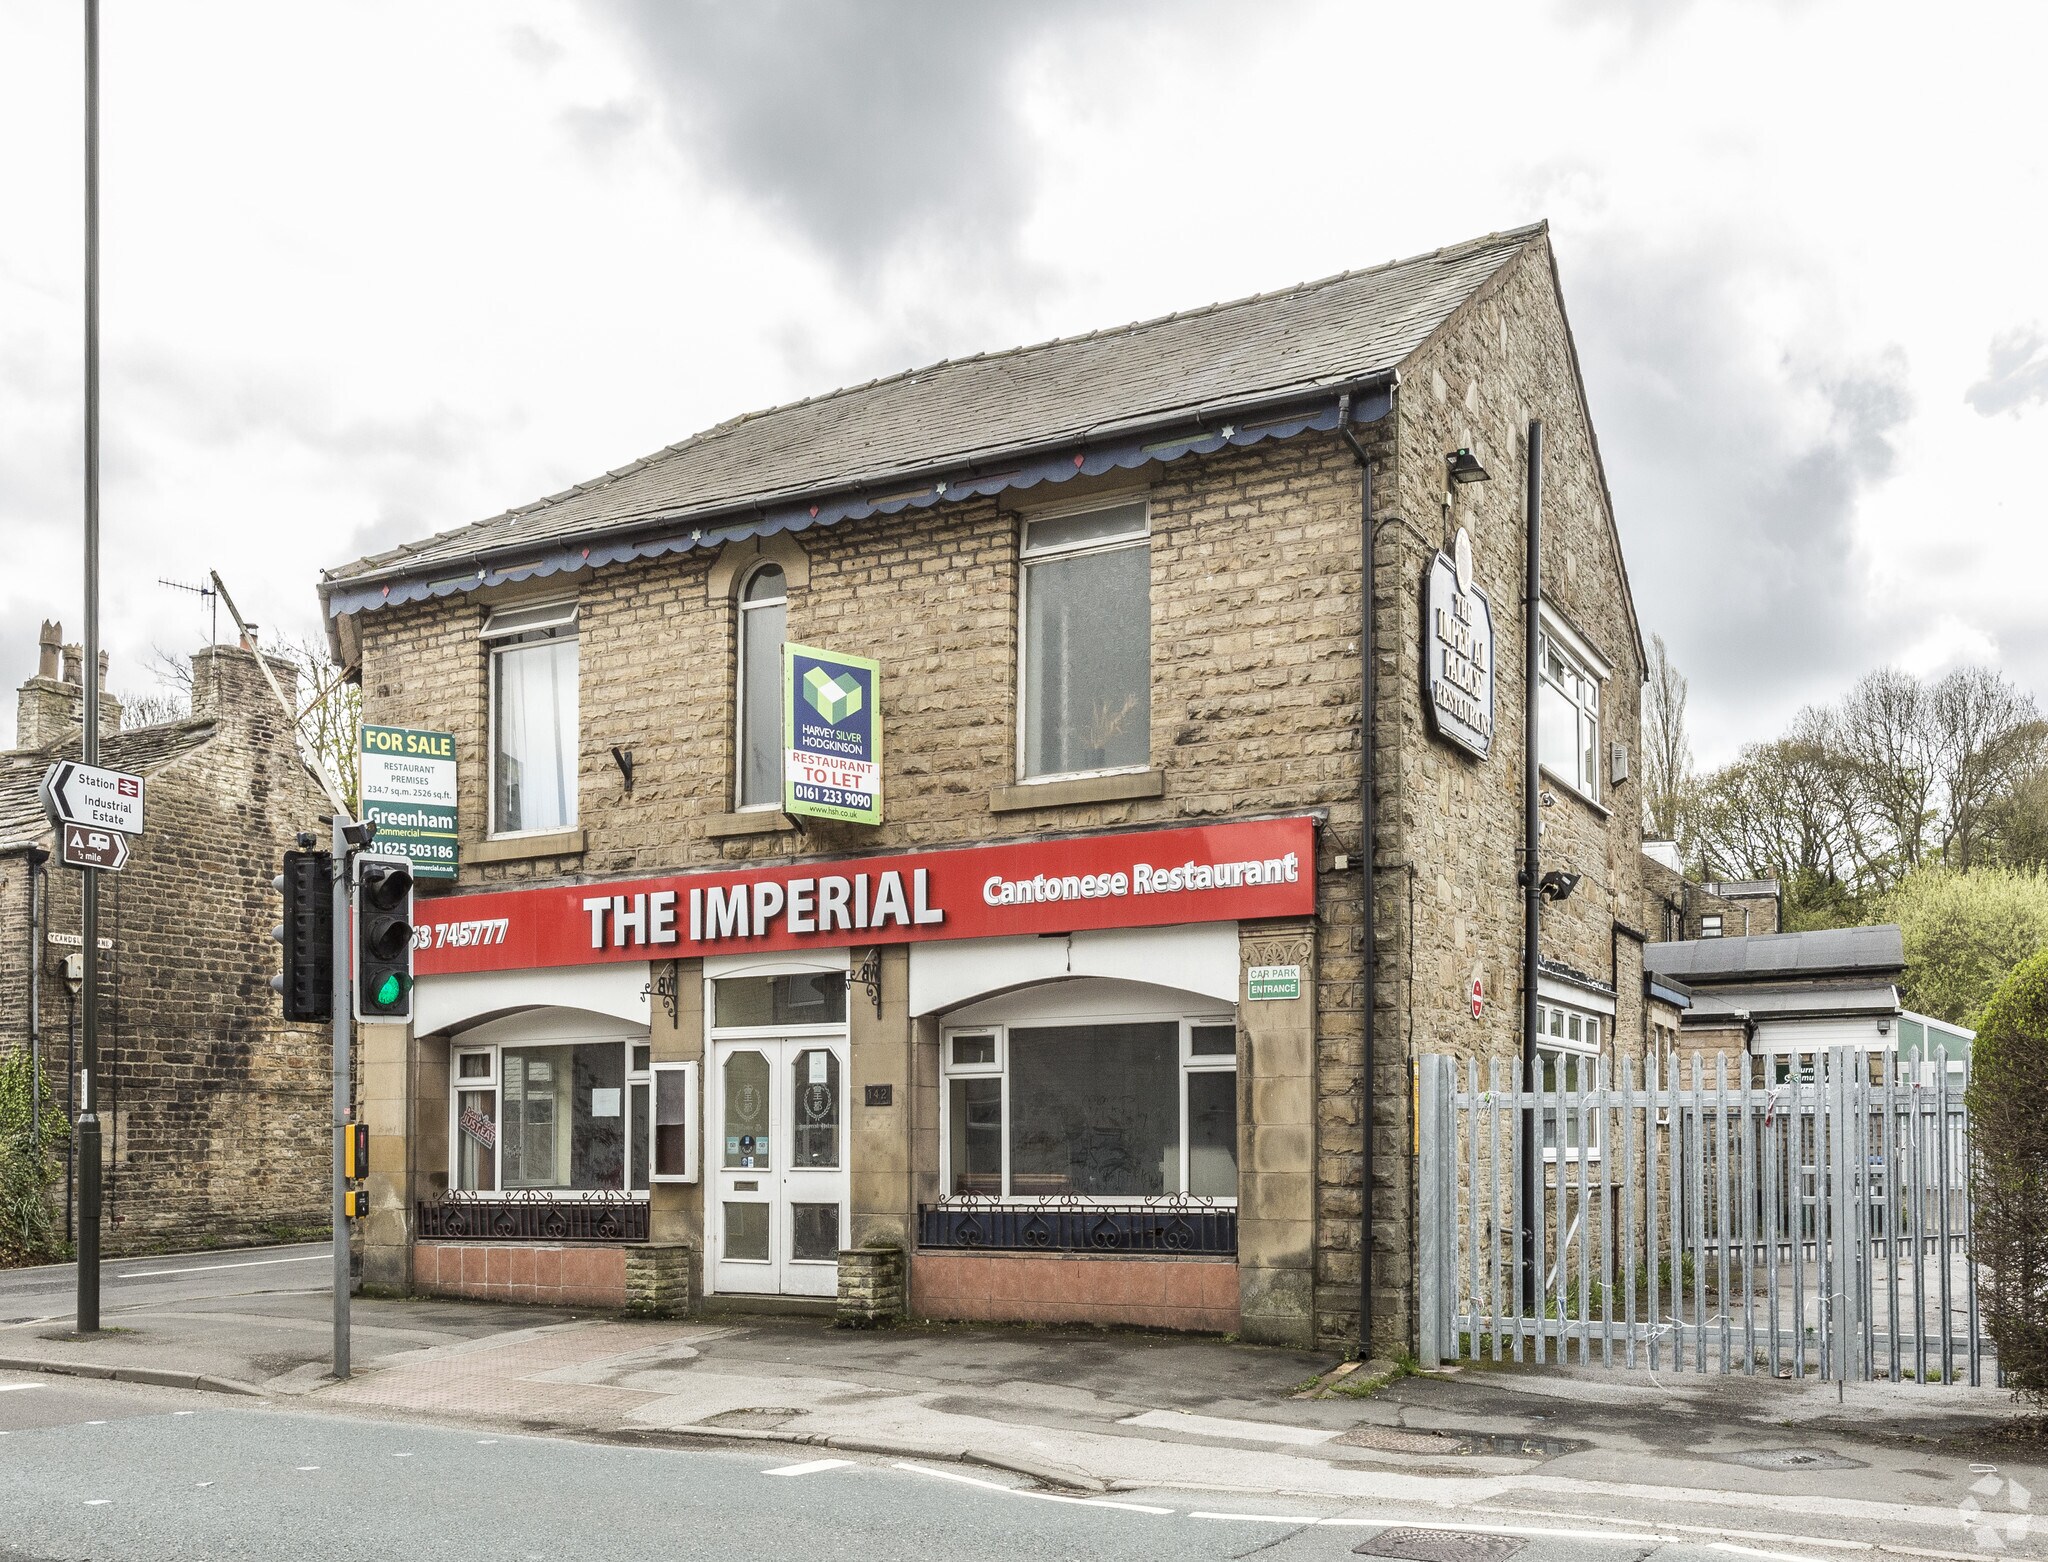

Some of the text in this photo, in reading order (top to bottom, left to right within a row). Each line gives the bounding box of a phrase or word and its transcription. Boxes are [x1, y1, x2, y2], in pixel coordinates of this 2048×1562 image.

[1455, 592, 1473, 625] THE
[1444, 649, 1483, 701] PALACE
[1435, 680, 1492, 738] RESTAURANT
[365, 730, 451, 756] FOR SALE
[802, 724, 862, 744] HARVEY SILVER
[802, 736, 863, 755] HODGKINSON
[384, 762, 435, 774] RESTAURANT
[793, 752, 873, 774] RESTAURANT
[79, 773, 116, 791] Station
[391, 774, 429, 786] PREMISES
[803, 767, 863, 789] TO LET
[367, 785, 452, 800] 234.7 sq.m. 2526 sq.ft.
[795, 785, 871, 808] 0161 233 9090
[84, 794, 132, 814] Industrial
[809, 805, 858, 819] www.hsh.co.uk
[92, 809, 125, 826] Estate
[367, 807, 453, 829] Greenham
[85, 852, 102, 863] mile
[369, 841, 454, 859] 01625 503186
[983, 851, 1299, 906] Cantonese Restaurant
[582, 868, 944, 949] THE IMPERIAL
[435, 918, 509, 949] 745777
[1250, 968, 1297, 979] CAR PARK
[1251, 983, 1296, 994] ENTRANCE
[867, 1088, 887, 1100] 142
[461, 1113, 480, 1134] JUST
[479, 1126, 496, 1144] EAT
